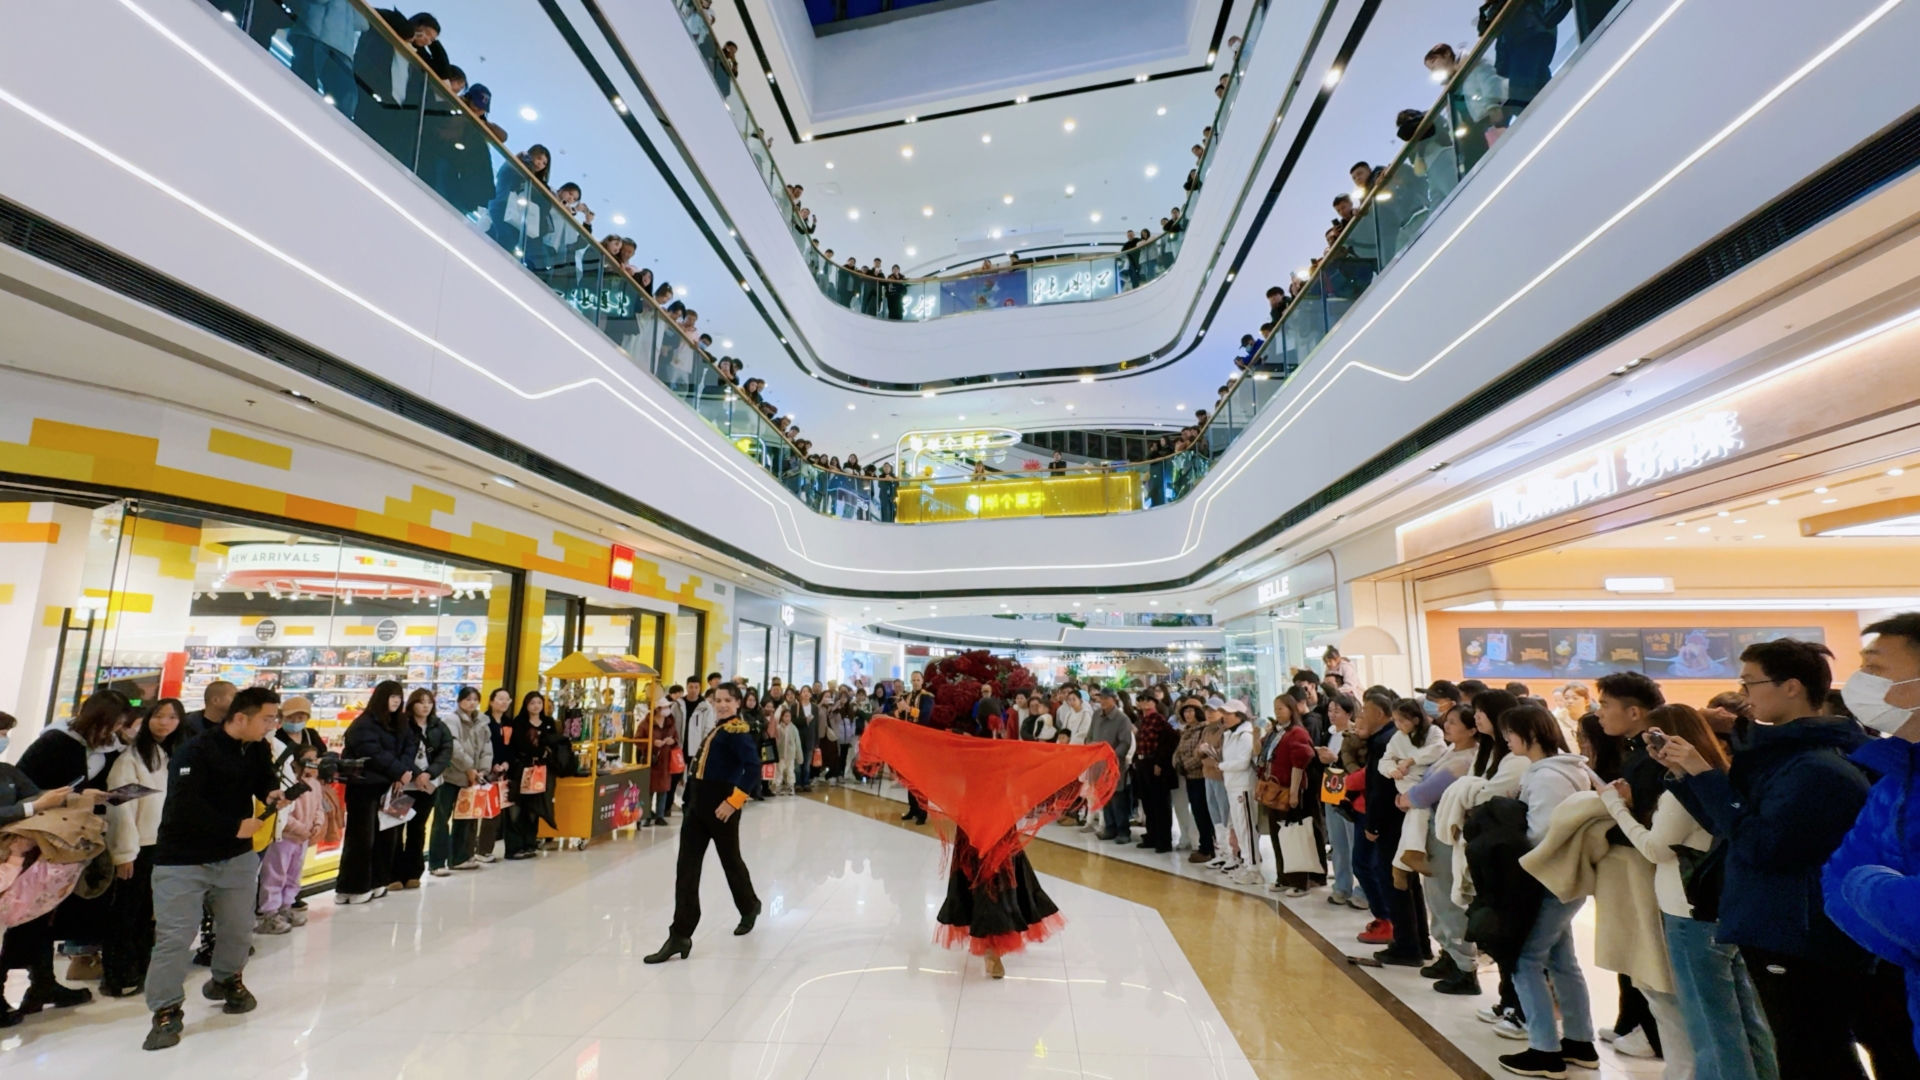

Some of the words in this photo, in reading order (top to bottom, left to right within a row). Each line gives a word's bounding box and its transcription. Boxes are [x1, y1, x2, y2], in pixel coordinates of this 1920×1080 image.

[231, 553, 248, 563] NEW
[251, 552, 320, 563] ARRIVALS
[1258, 576, 1290, 604] BELLE
